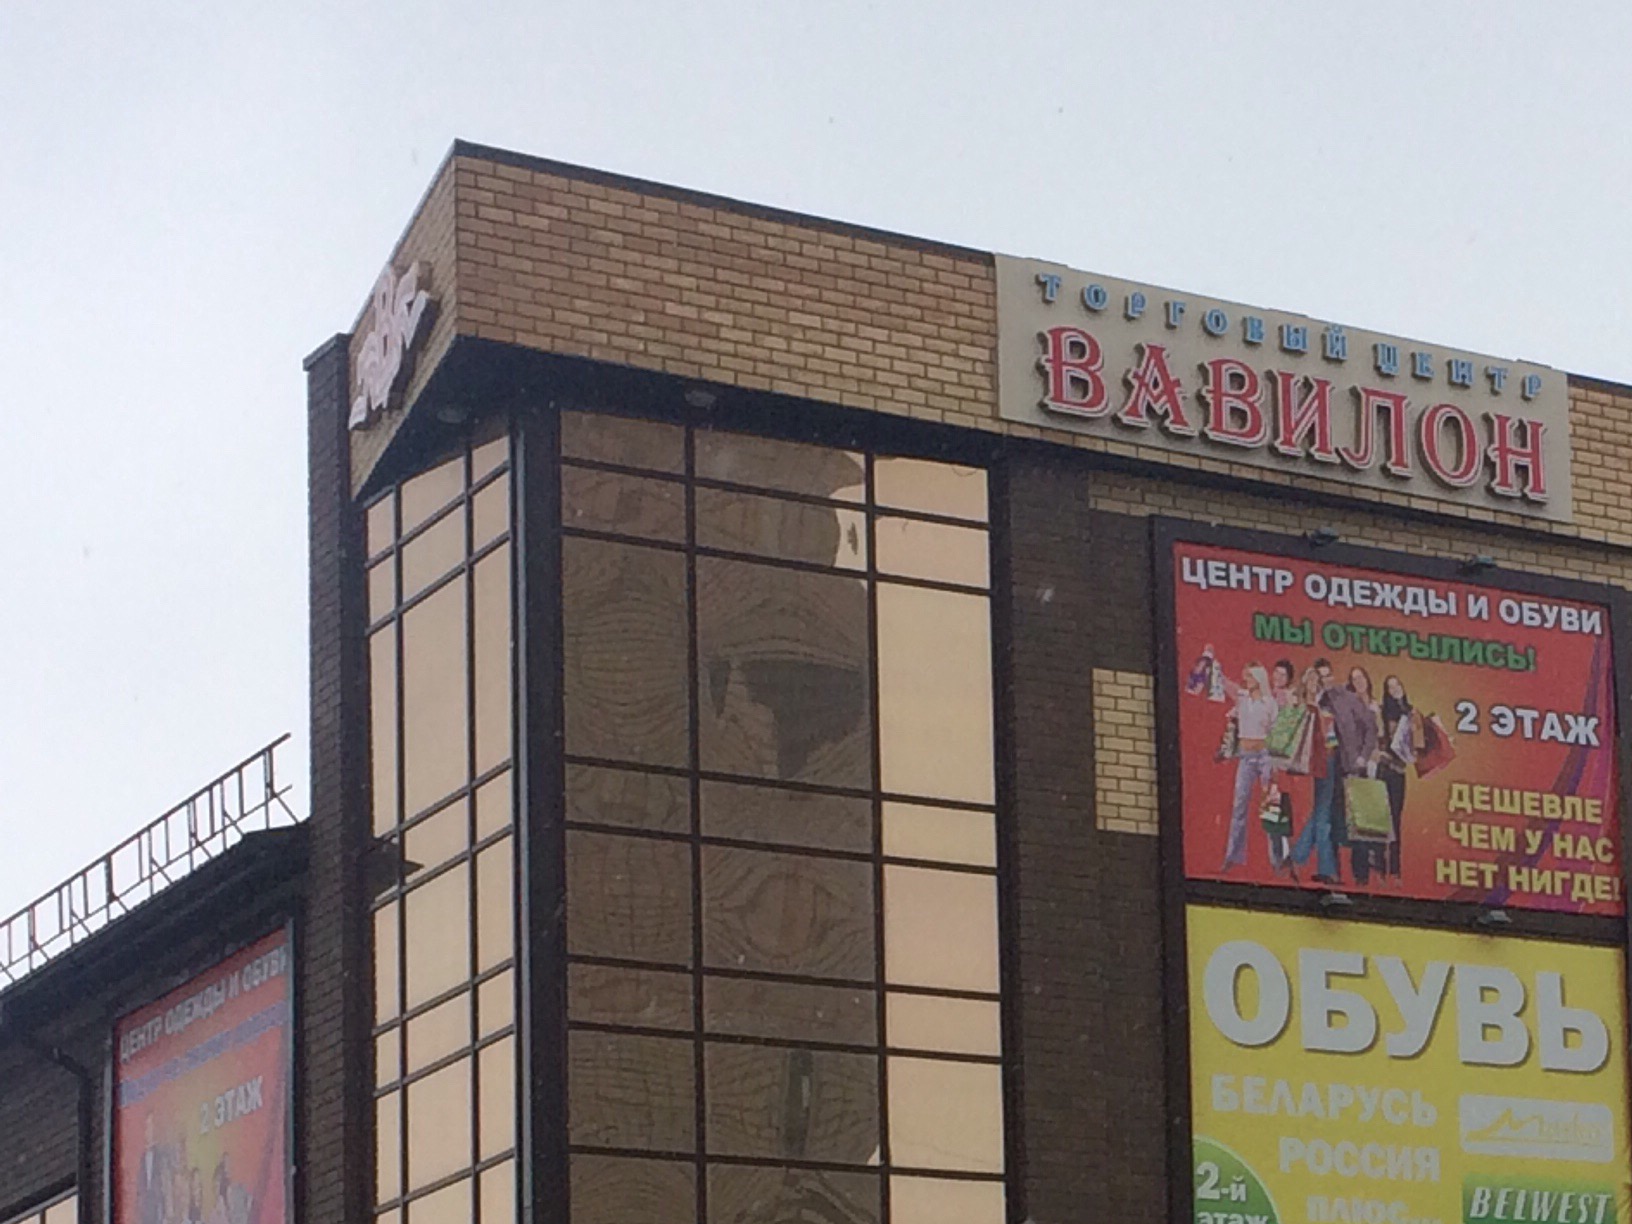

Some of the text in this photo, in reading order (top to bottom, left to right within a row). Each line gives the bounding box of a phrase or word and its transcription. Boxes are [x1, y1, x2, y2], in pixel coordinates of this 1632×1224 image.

[1037, 273, 1543, 398] ТОРГОВЫЙ ЦЕНТР
[1042, 326, 1548, 501] ВАВИЛОН
[1182, 557, 1602, 635] ЦЕНТР ОДЕЖДЫ И ОБУВИ
[1253, 614, 1536, 671] МЫ ОТКРЫЛИСЬ!
[1456, 701, 1600, 746] 2 ЭТАЖ
[1448, 783, 1602, 824] ДЕШЕВЛЕ
[1448, 822, 1615, 863] ЧЕМ У НАС
[1436, 859, 1622, 904] НЕТ НИГДЕ!
[121, 1016, 162, 1063] ЦЕНТР
[165, 978, 225, 1035] ОДЕЖДЫ
[228, 970, 240, 998] И
[1204, 939, 1610, 1073] ОБУВЬ
[199, 1075, 263, 1134] 2 ЭТАЖ
[1212, 1074, 1438, 1127] БЕЛАРУСЬ
[1196, 1162, 1247, 1202] 2-й
[1278, 1136, 1441, 1183] РОССИЯ
